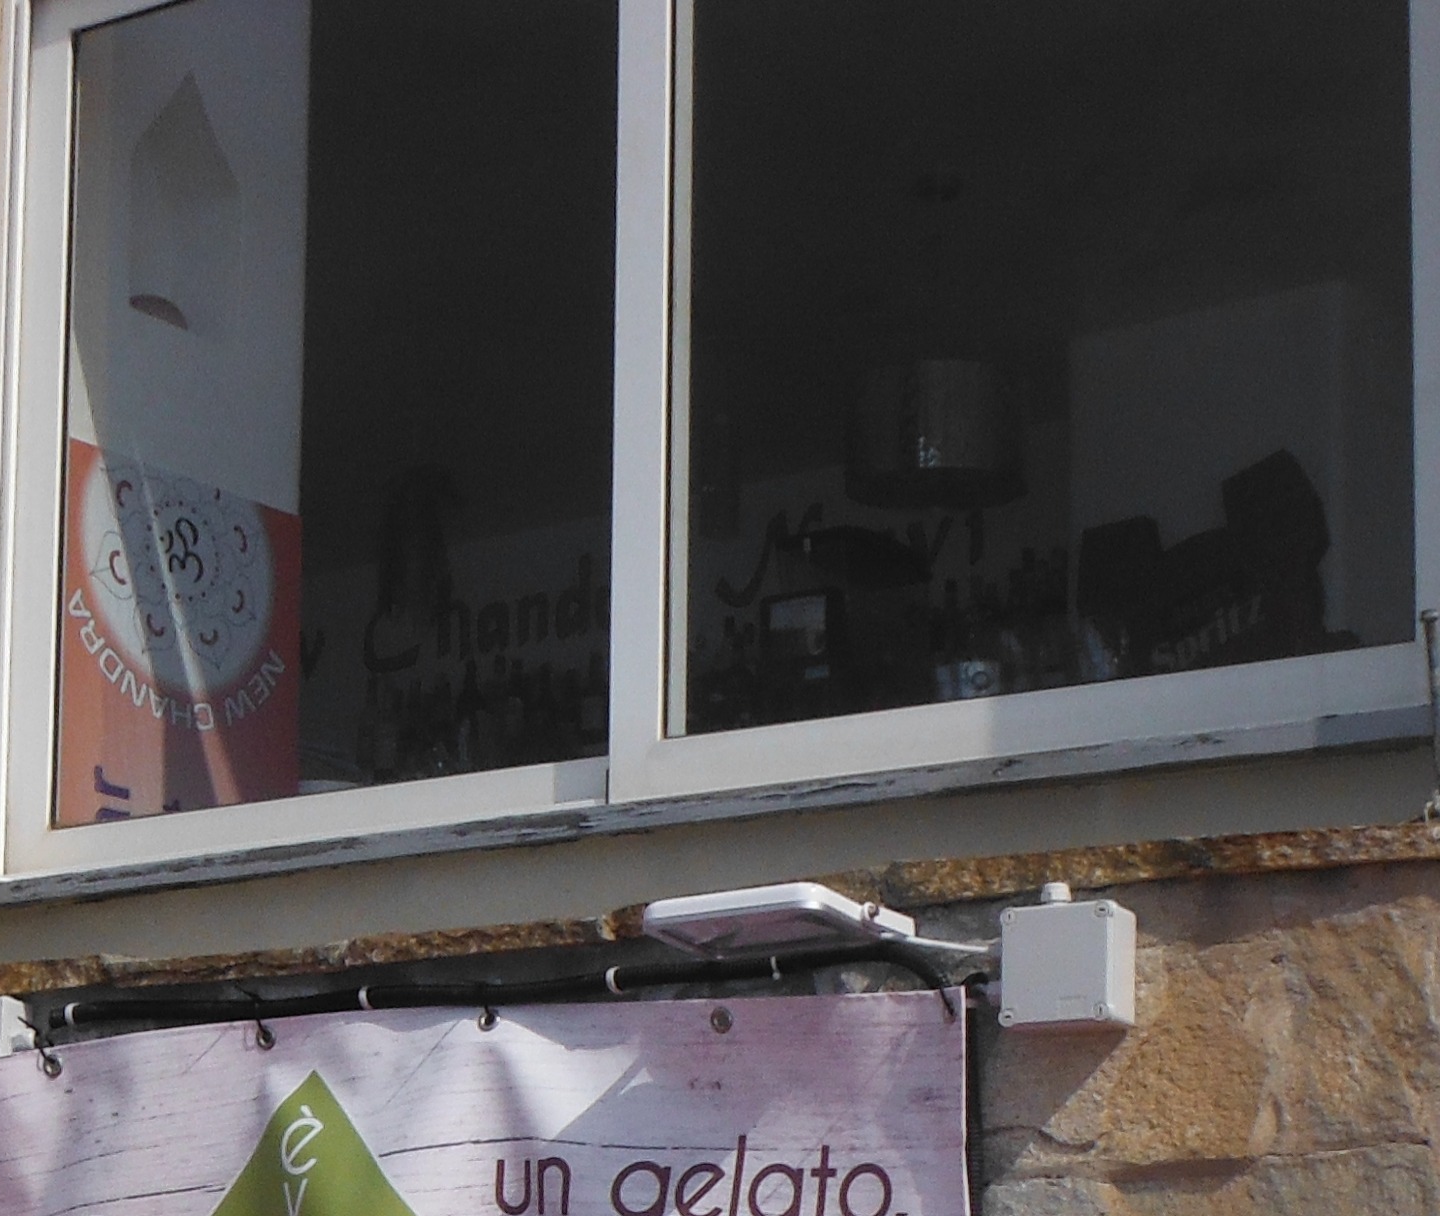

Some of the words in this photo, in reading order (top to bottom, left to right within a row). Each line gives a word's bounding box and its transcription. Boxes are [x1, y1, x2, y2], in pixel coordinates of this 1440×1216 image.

[69, 587, 215, 732] CHANDRA
[226, 650, 286, 727] NEW
[281, 1104, 324, 1176] è
[495, 1157, 572, 1216] un
